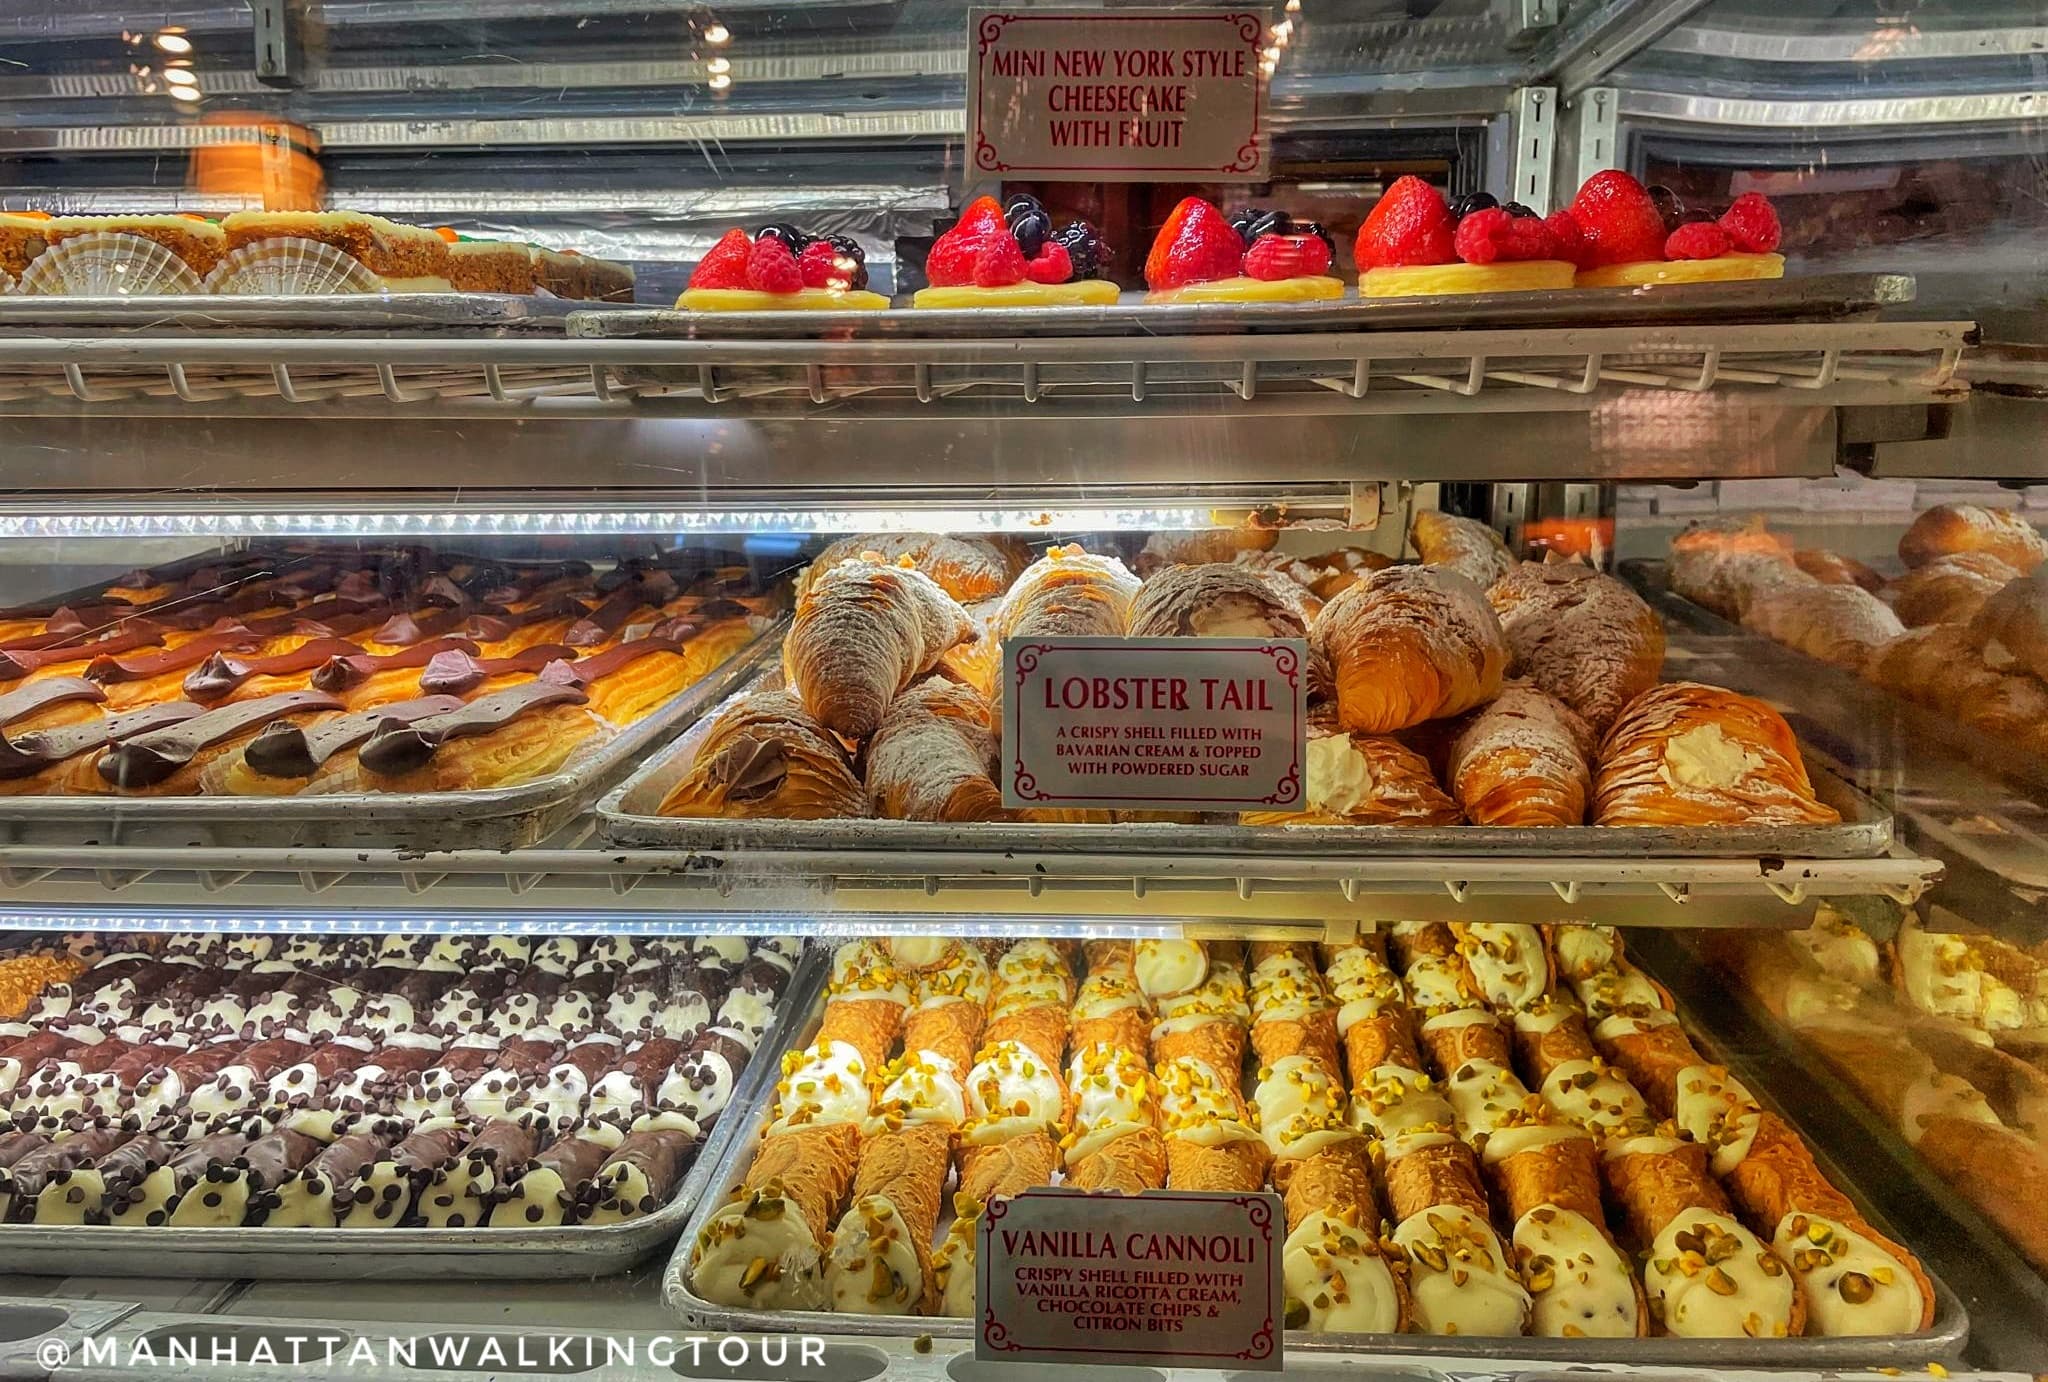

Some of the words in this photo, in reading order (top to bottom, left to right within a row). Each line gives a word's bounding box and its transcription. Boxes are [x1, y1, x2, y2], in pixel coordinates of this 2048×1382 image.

[993, 50, 1045, 77] MINI
[1054, 50, 1105, 77] NEW
[1113, 50, 1175, 77] YORK
[1182, 50, 1245, 77] STYLE
[1048, 85, 1186, 112] CHEESECAKE
[1050, 120, 1111, 147] WITH
[1118, 120, 1183, 147] FRUIT
[1045, 677, 1189, 710] LOBSTER
[1201, 679, 1273, 711] TAIL
[1056, 727, 1066, 738] A
[1071, 727, 1119, 739] CRISPY
[1124, 727, 1166, 739] SHELL
[1170, 728, 1217, 740] FILLED
[1222, 728, 1262, 741] WITH
[1056, 744, 1131, 757] BAVARIAN
[1135, 745, 1185, 757] CREAM
[1190, 746, 1200, 758] &
[1205, 746, 1261, 758] TOPPED
[1068, 762, 1107, 775] WITH
[1112, 763, 1194, 776] POWDERED
[1200, 764, 1249, 776] SUGAR
[1002, 1230, 1117, 1259] VANILLA
[1126, 1234, 1254, 1263] CANNOLI
[1015, 1267, 1074, 1282] CRISPY
[1079, 1269, 1128, 1284] SHELL
[1134, 1270, 1190, 1286] FILLED
[1195, 1273, 1243, 1287] WITH
[1017, 1283, 1089, 1299] VANILLA
[1095, 1285, 1171, 1300] RICOTTA
[1176, 1288, 1241, 1305] CREAM,
[1037, 1299, 1145, 1315] CHOCOLATE
[1151, 1302, 1201, 1317] CHIPS
[1207, 1305, 1219, 1318] &
[1073, 1316, 1142, 1331] CITRON
[1148, 1318, 1184, 1332] BITS
